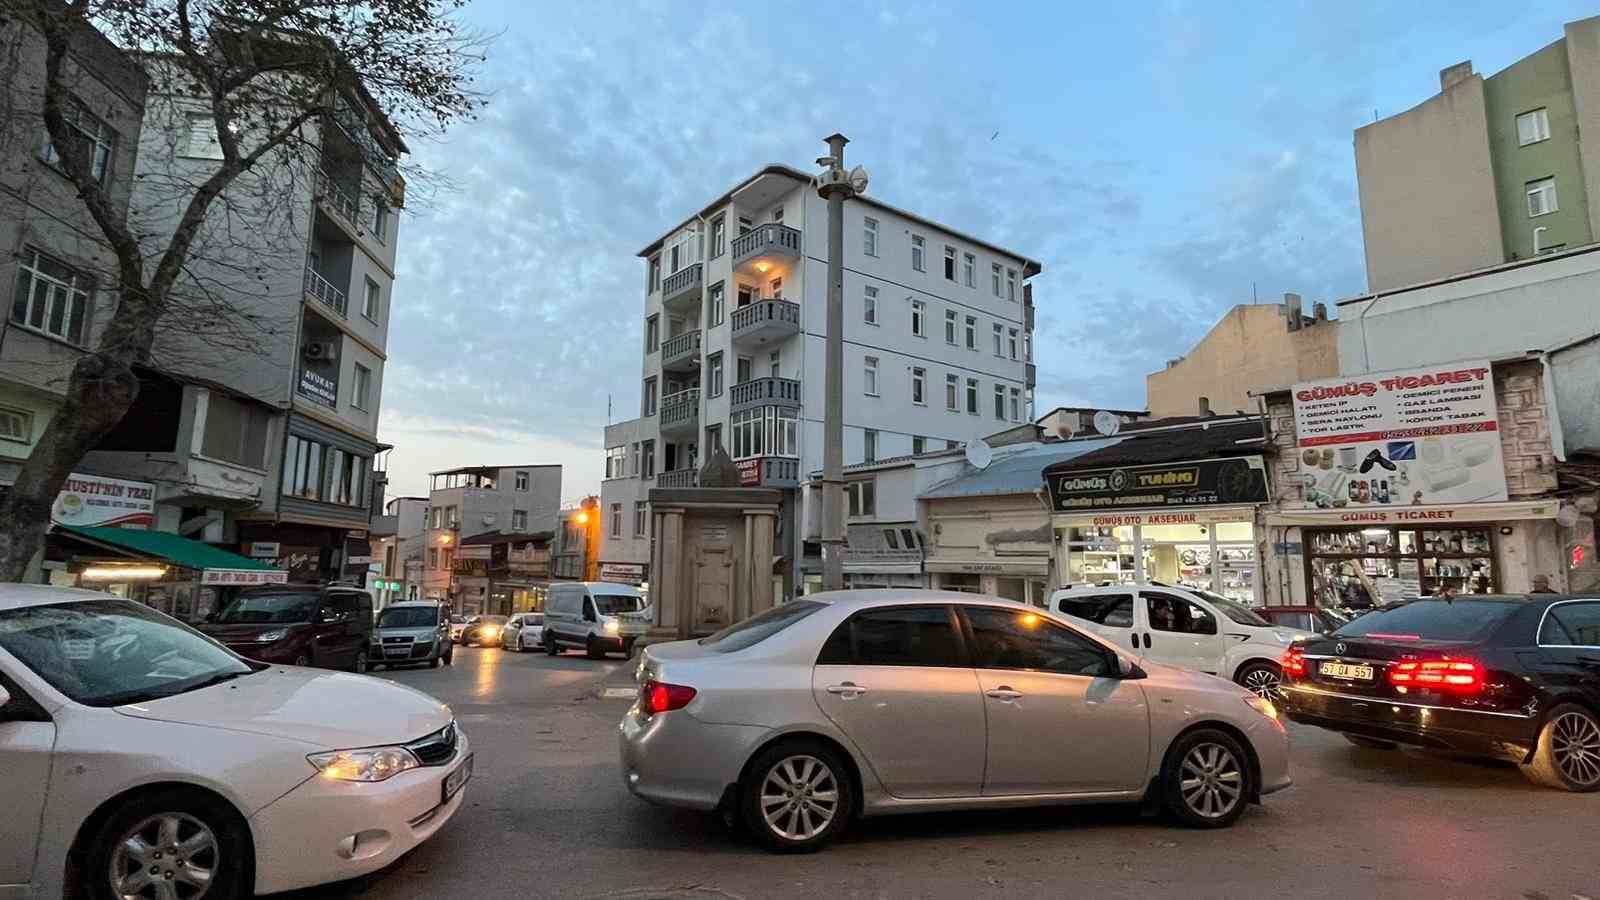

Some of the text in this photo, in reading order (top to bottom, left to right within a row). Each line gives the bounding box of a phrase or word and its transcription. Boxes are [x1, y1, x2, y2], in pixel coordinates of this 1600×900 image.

[304, 370, 335, 390] AVUKAT
[1296, 367, 1489, 401] GÜMÜŞ TİCARET
[1124, 515, 1141, 525] OTO
[1148, 513, 1196, 524] AKSESUAR
[1342, 511, 1387, 521] GÜMÜŞ
